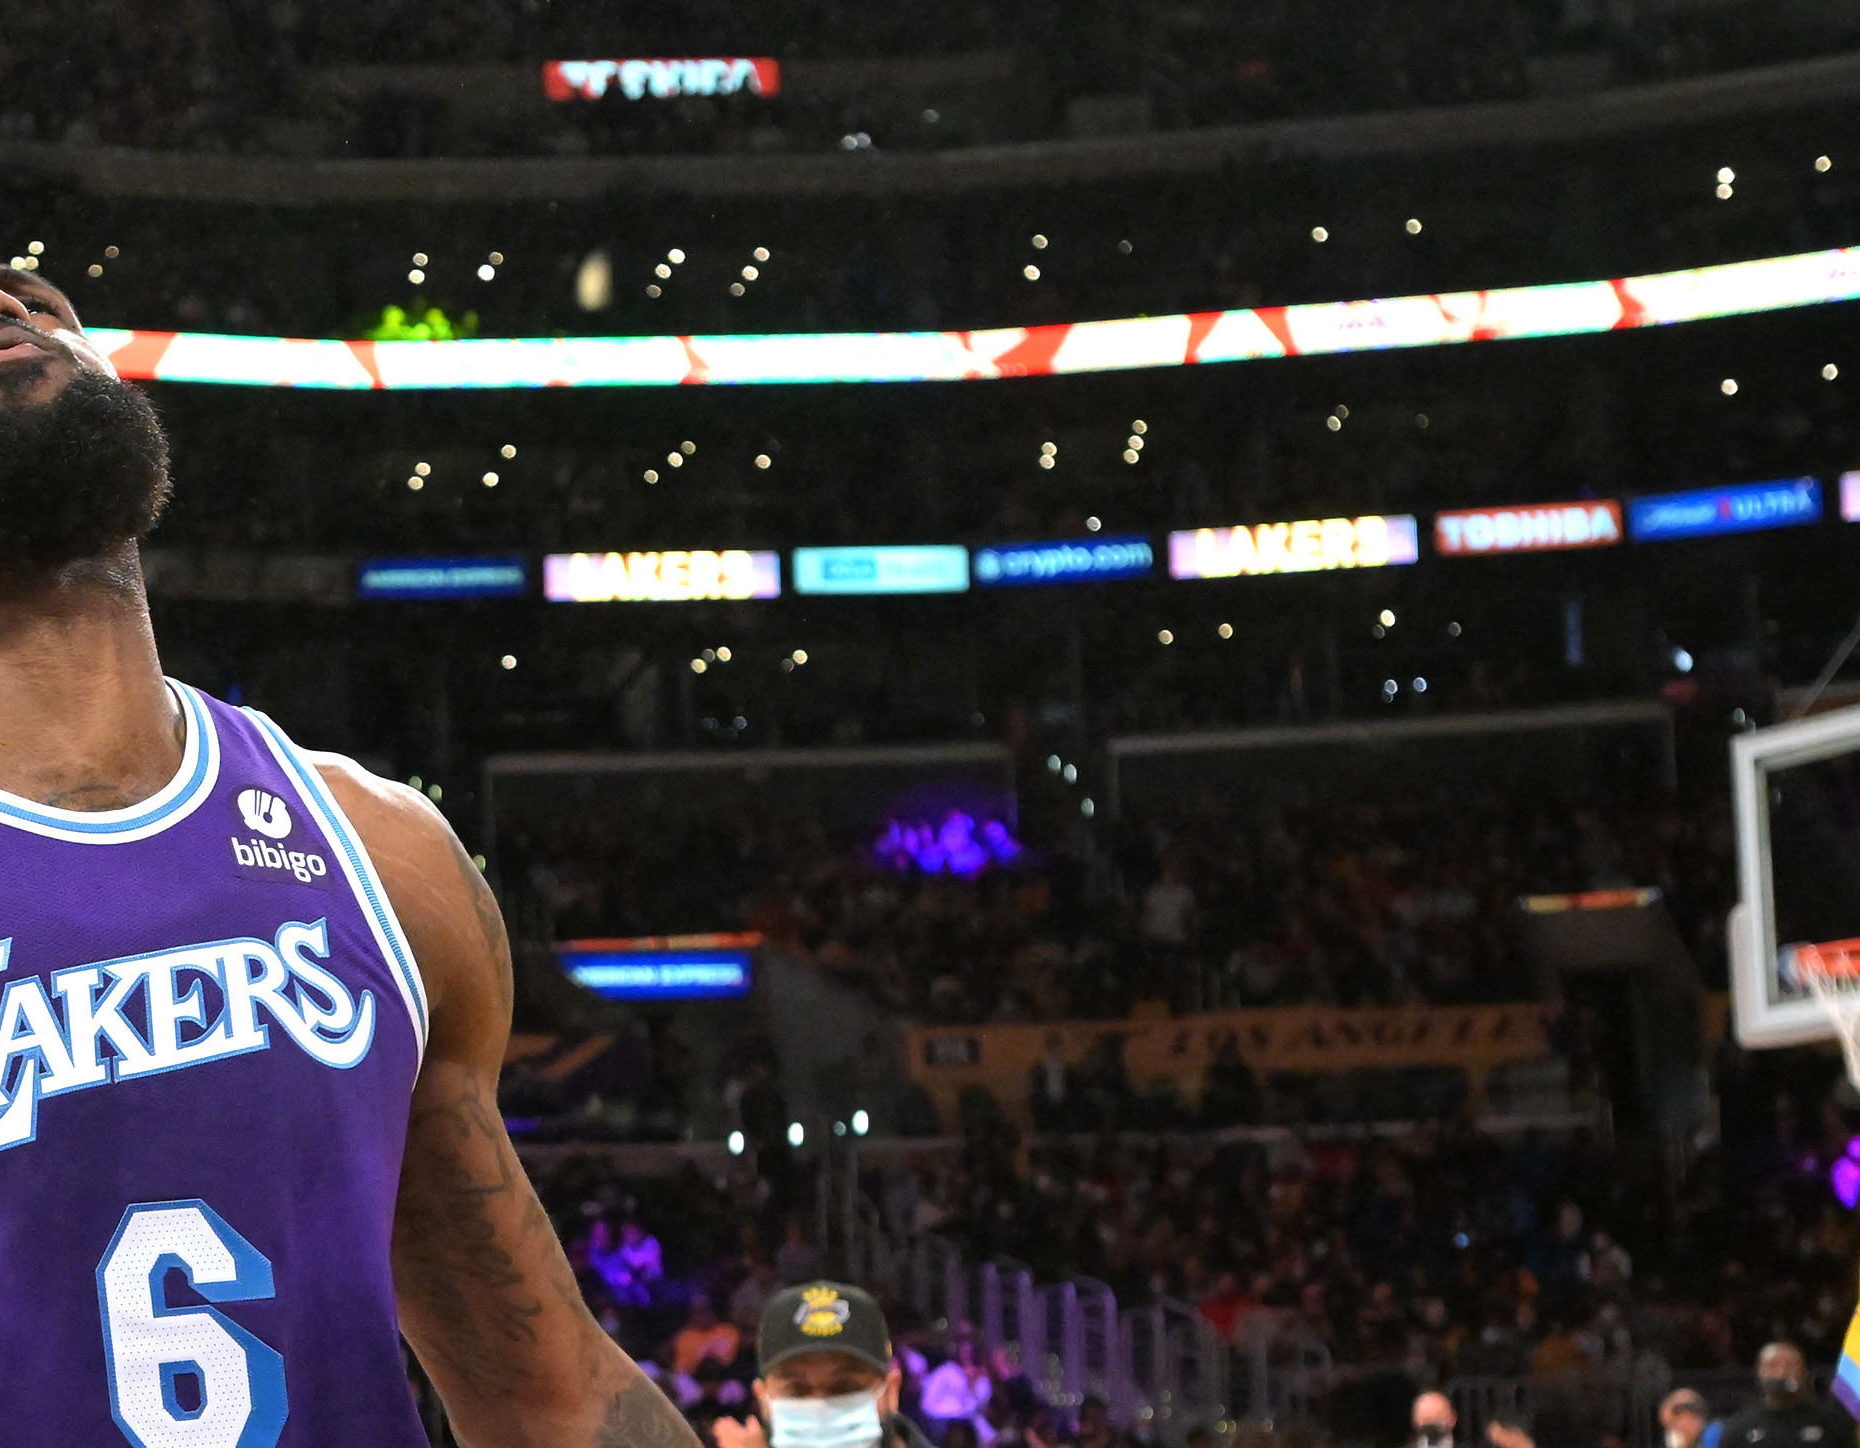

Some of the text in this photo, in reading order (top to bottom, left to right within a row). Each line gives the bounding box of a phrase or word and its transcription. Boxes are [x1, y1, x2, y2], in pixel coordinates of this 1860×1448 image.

[1195, 514, 1390, 579] LAKERS
[1440, 501, 1617, 552] TOSHIBA
[569, 550, 753, 602] LAKERS
[1001, 542, 1153, 580] crypto.com
[234, 833, 327, 884] bibigo
